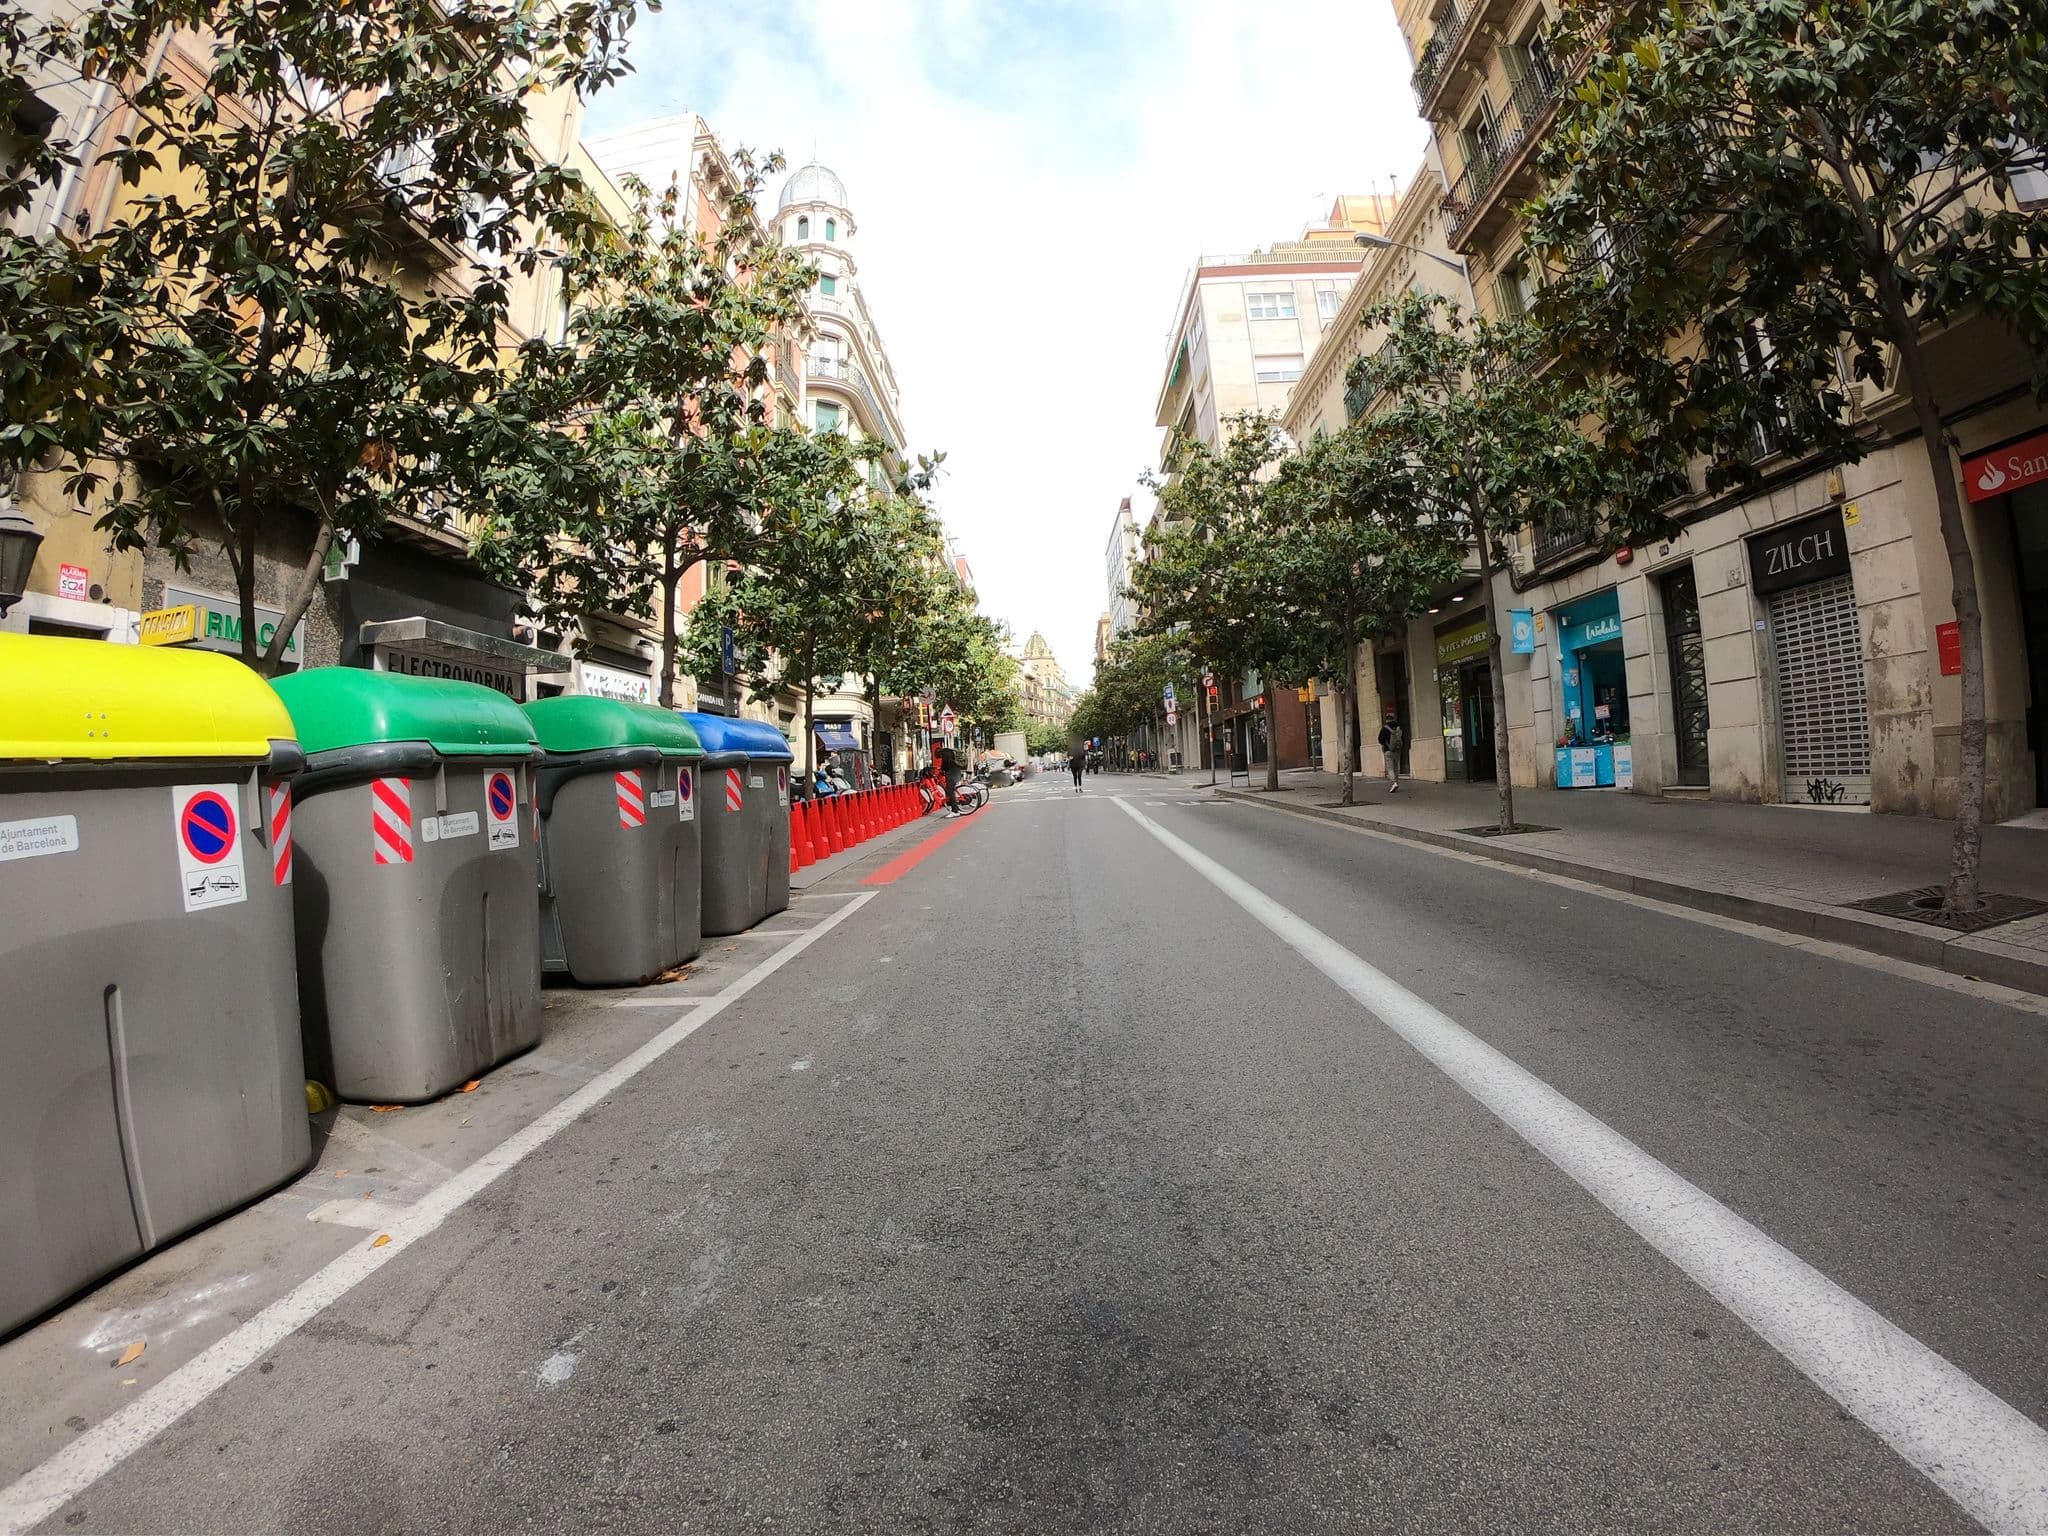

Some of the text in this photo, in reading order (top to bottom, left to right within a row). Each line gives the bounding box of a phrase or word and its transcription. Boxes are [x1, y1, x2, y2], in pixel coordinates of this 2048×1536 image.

[2008, 454, 2048, 481] San
[1765, 530, 1835, 577] ZILCH
[0, 825, 59, 842] Ajuntament
[1, 837, 68, 854] de Barcelona
